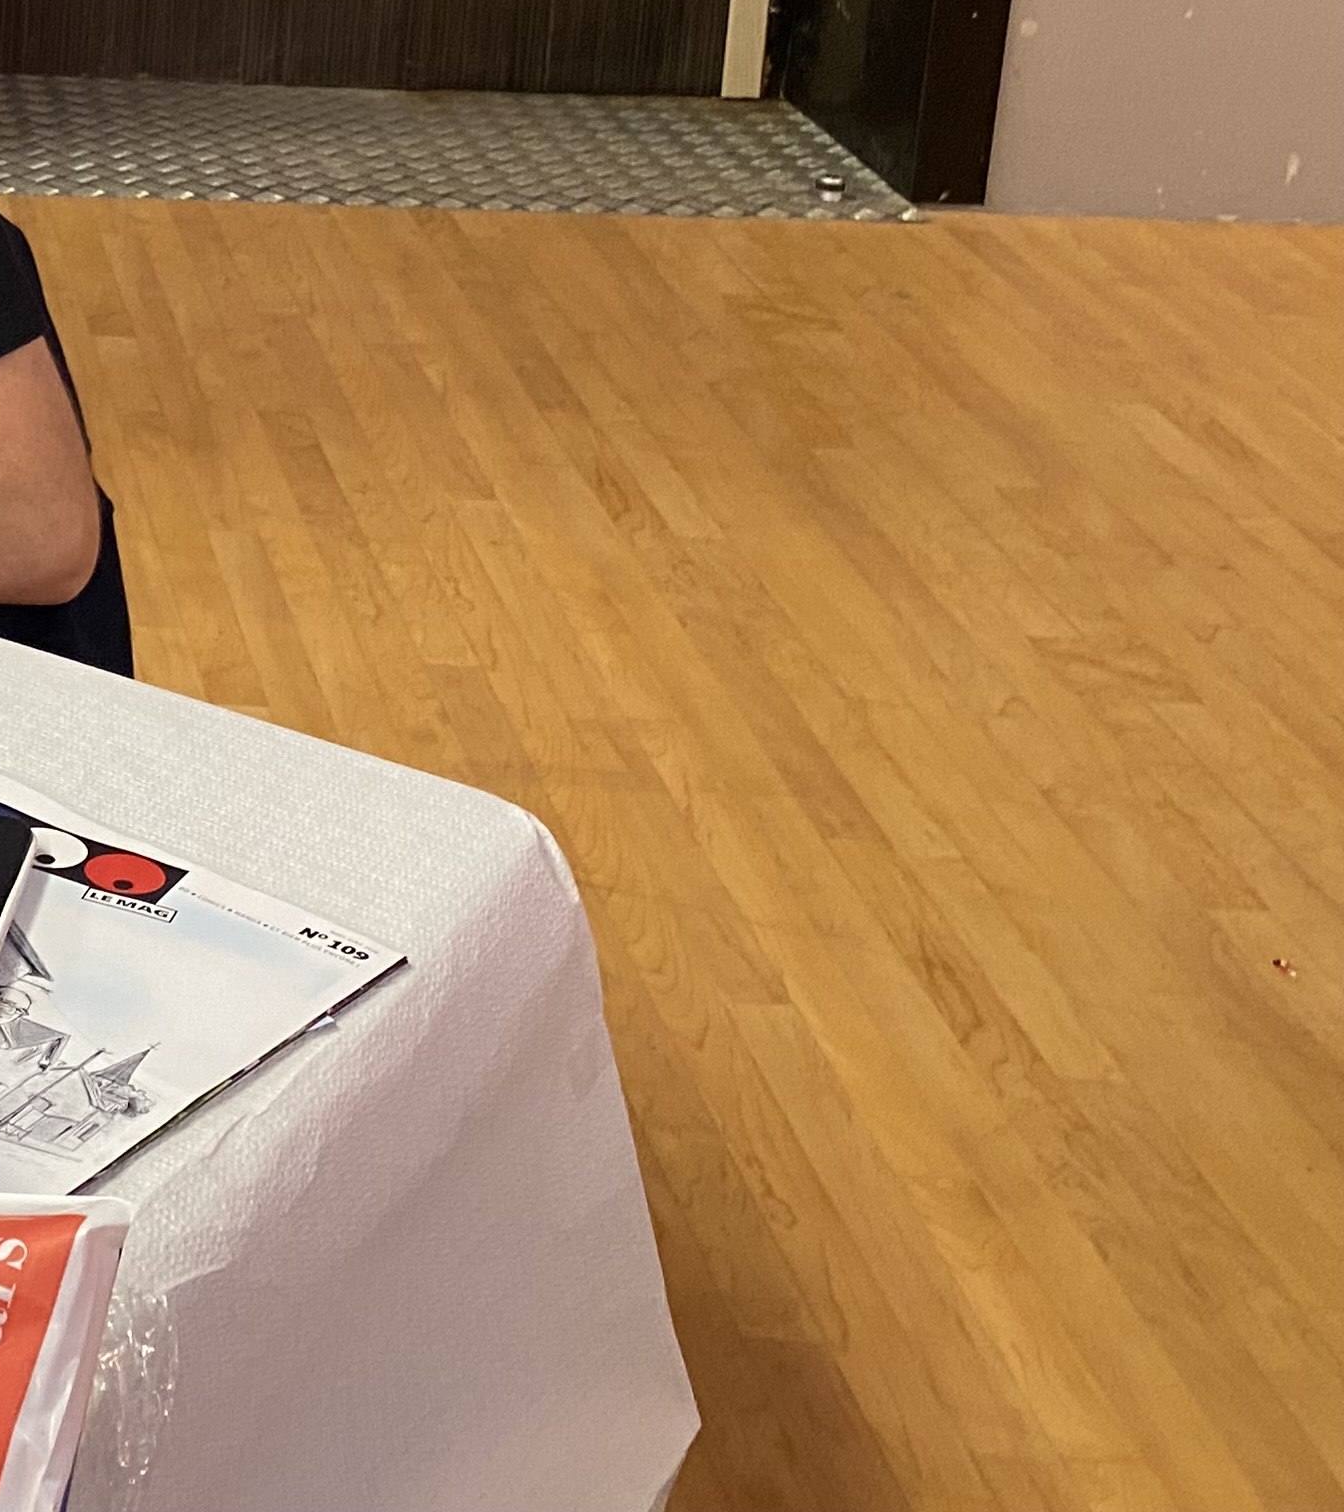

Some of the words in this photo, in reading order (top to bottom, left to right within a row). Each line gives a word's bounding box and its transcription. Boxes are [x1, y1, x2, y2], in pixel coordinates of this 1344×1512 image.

[89, 891, 112, 904] LE
[115, 897, 172, 920] MAG
[327, 940, 370, 960] 109
